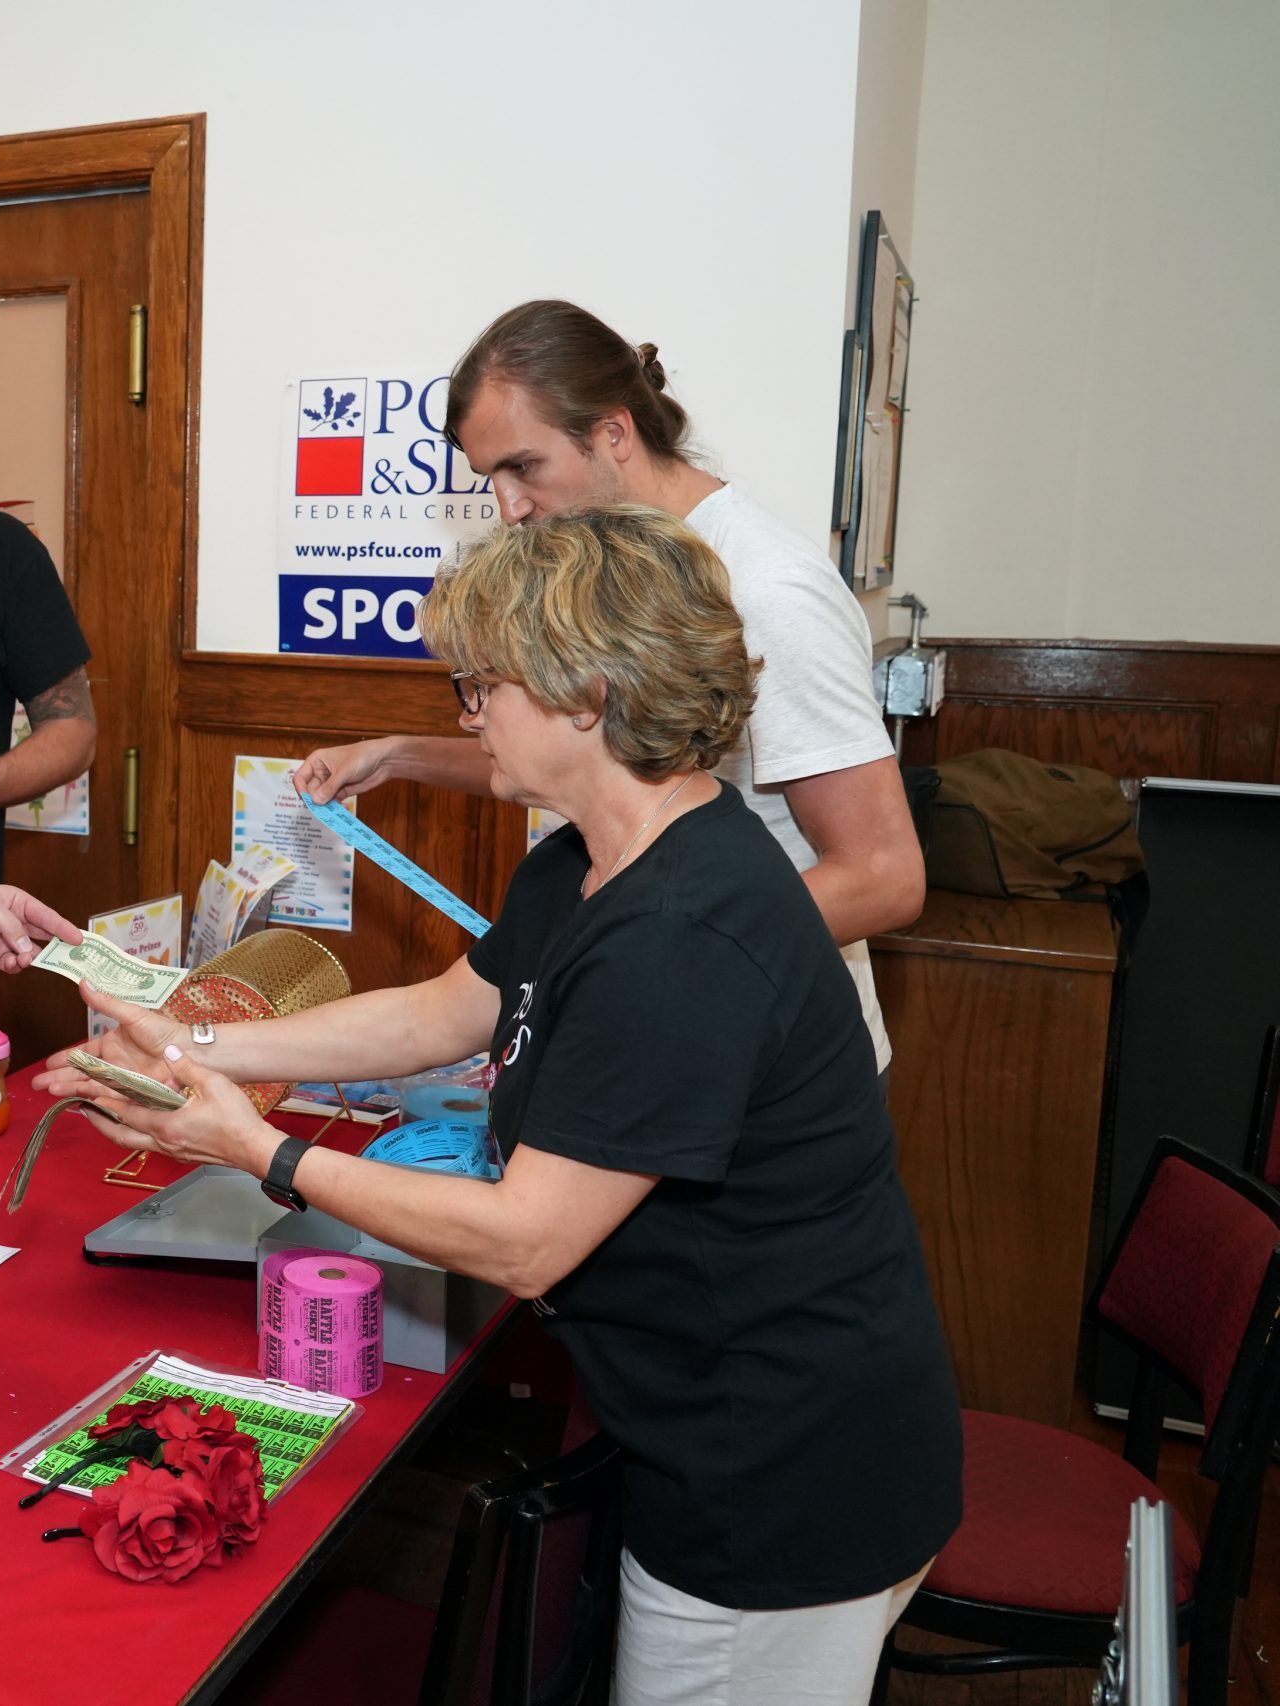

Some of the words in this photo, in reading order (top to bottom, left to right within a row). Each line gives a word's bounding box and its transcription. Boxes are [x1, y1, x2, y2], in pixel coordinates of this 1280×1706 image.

[295, 504, 408, 520] FEDERAL
[295, 541, 441, 561] www.psfcu.com
[272, 1285, 281, 1333] RAFFLE
[309, 1297, 318, 1342] TICKET
[320, 1297, 333, 1345] RAFFLE
[369, 1289, 378, 1338] RAFFLE
[366, 1343, 374, 1392] RAFFLE
